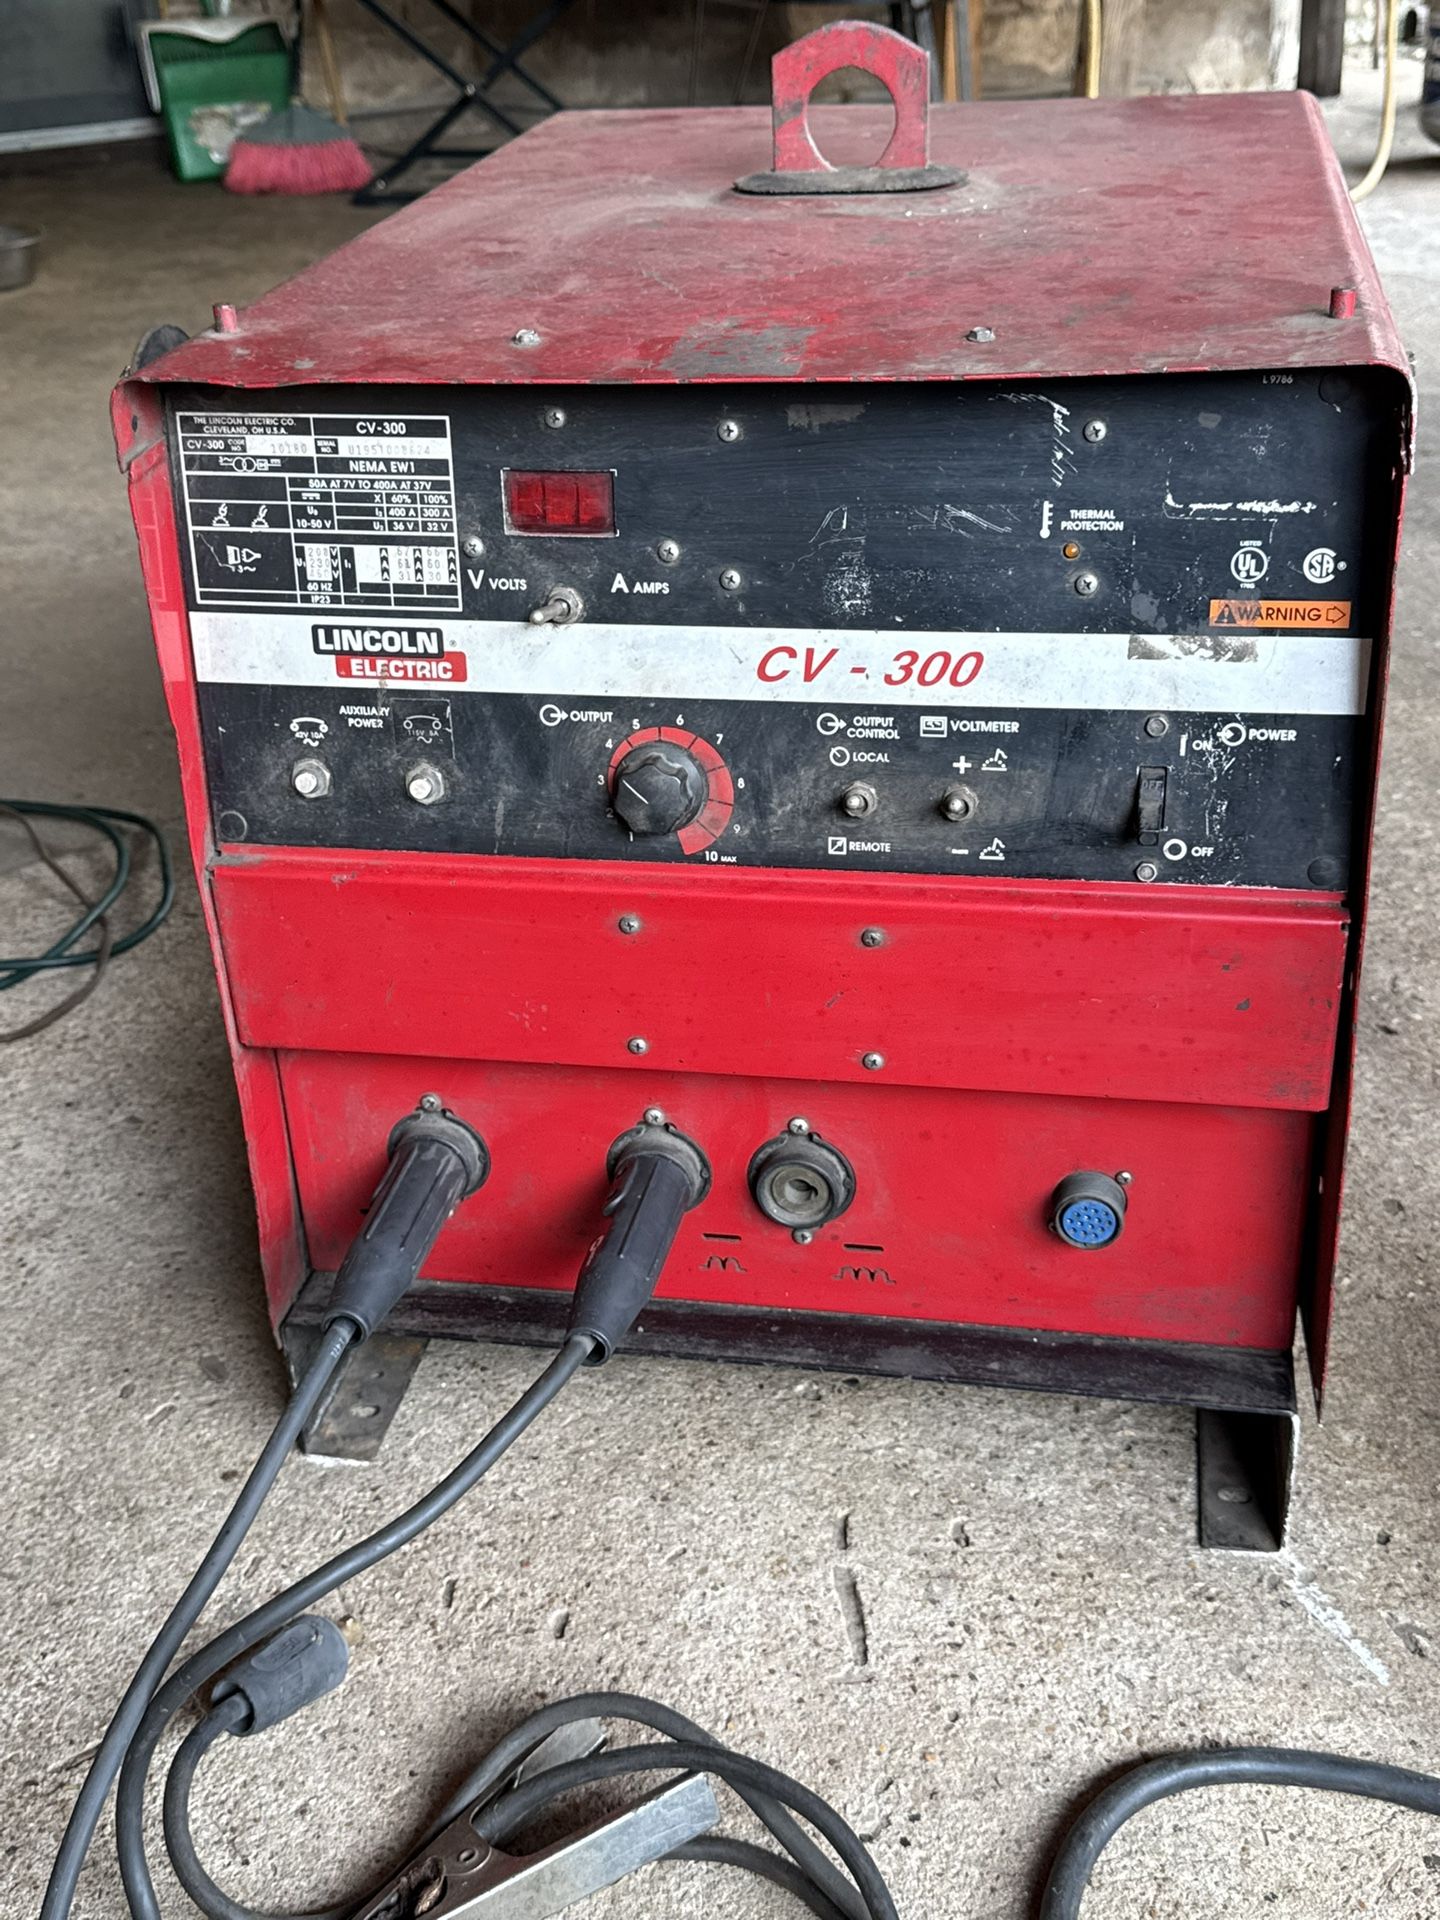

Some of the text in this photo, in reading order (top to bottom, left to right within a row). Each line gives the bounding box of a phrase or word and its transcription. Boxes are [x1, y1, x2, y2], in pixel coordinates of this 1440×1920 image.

[193, 417, 206, 425] THE
[209, 417, 242, 425] LINCOLN
[280, 418, 296, 426] CO.
[203, 426, 250, 434] CLEVELAND,
[266, 427, 288, 435] U.S.A.
[356, 421, 406, 435] CV-300
[187, 440, 225, 450] CV-300
[349, 460, 415, 473] NEMA EW1
[308, 479, 432, 490] 50A AT 7V TO 400A AT 37V
[374, 494, 381, 503] X
[391, 494, 411, 503] 60%
[423, 495, 448, 504] 100%
[388, 508, 416, 517] 400 A
[422, 508, 450, 517] 300 A
[1070, 510, 1116, 520] THERMAL
[296, 519, 332, 529] 10-50 V
[393, 522, 414, 531] 36 V
[427, 522, 448, 531] 32 V
[1061, 520, 1124, 532] PROTECTION
[309, 558, 330, 568] 230
[467, 569, 527, 591] V VOLTS
[611, 573, 670, 595] A AMPS
[307, 583, 332, 591] 60 HZ
[311, 595, 331, 604] IP23
[1238, 606, 1322, 621] WARNING
[317, 628, 439, 654] LINCOLN
[350, 658, 453, 680] ELECTRIC
[883, 650, 985, 687] 300
[339, 705, 390, 717] AUXILIARY
[570, 711, 613, 723] OUTPUT
[676, 715, 684, 726] 6
[853, 716, 894, 728] OUTPUT
[348, 718, 383, 729] POWER
[632, 719, 641, 730] 5
[950, 720, 1020, 733] VOLTMETER
[716, 734, 724, 745] 7
[846, 728, 900, 740] CONTROL
[1249, 729, 1297, 741] POWER
[605, 739, 613, 749] 4
[1192, 740, 1211, 750] ON
[853, 752, 890, 763] LOCAL
[597, 775, 605, 785] 3
[737, 778, 745, 789] 8
[606, 808, 614, 819] 2
[733, 824, 741, 834] 9
[849, 841, 891, 852] REMOTE
[1191, 847, 1214, 857] OFF
[705, 851, 718, 862] 10
